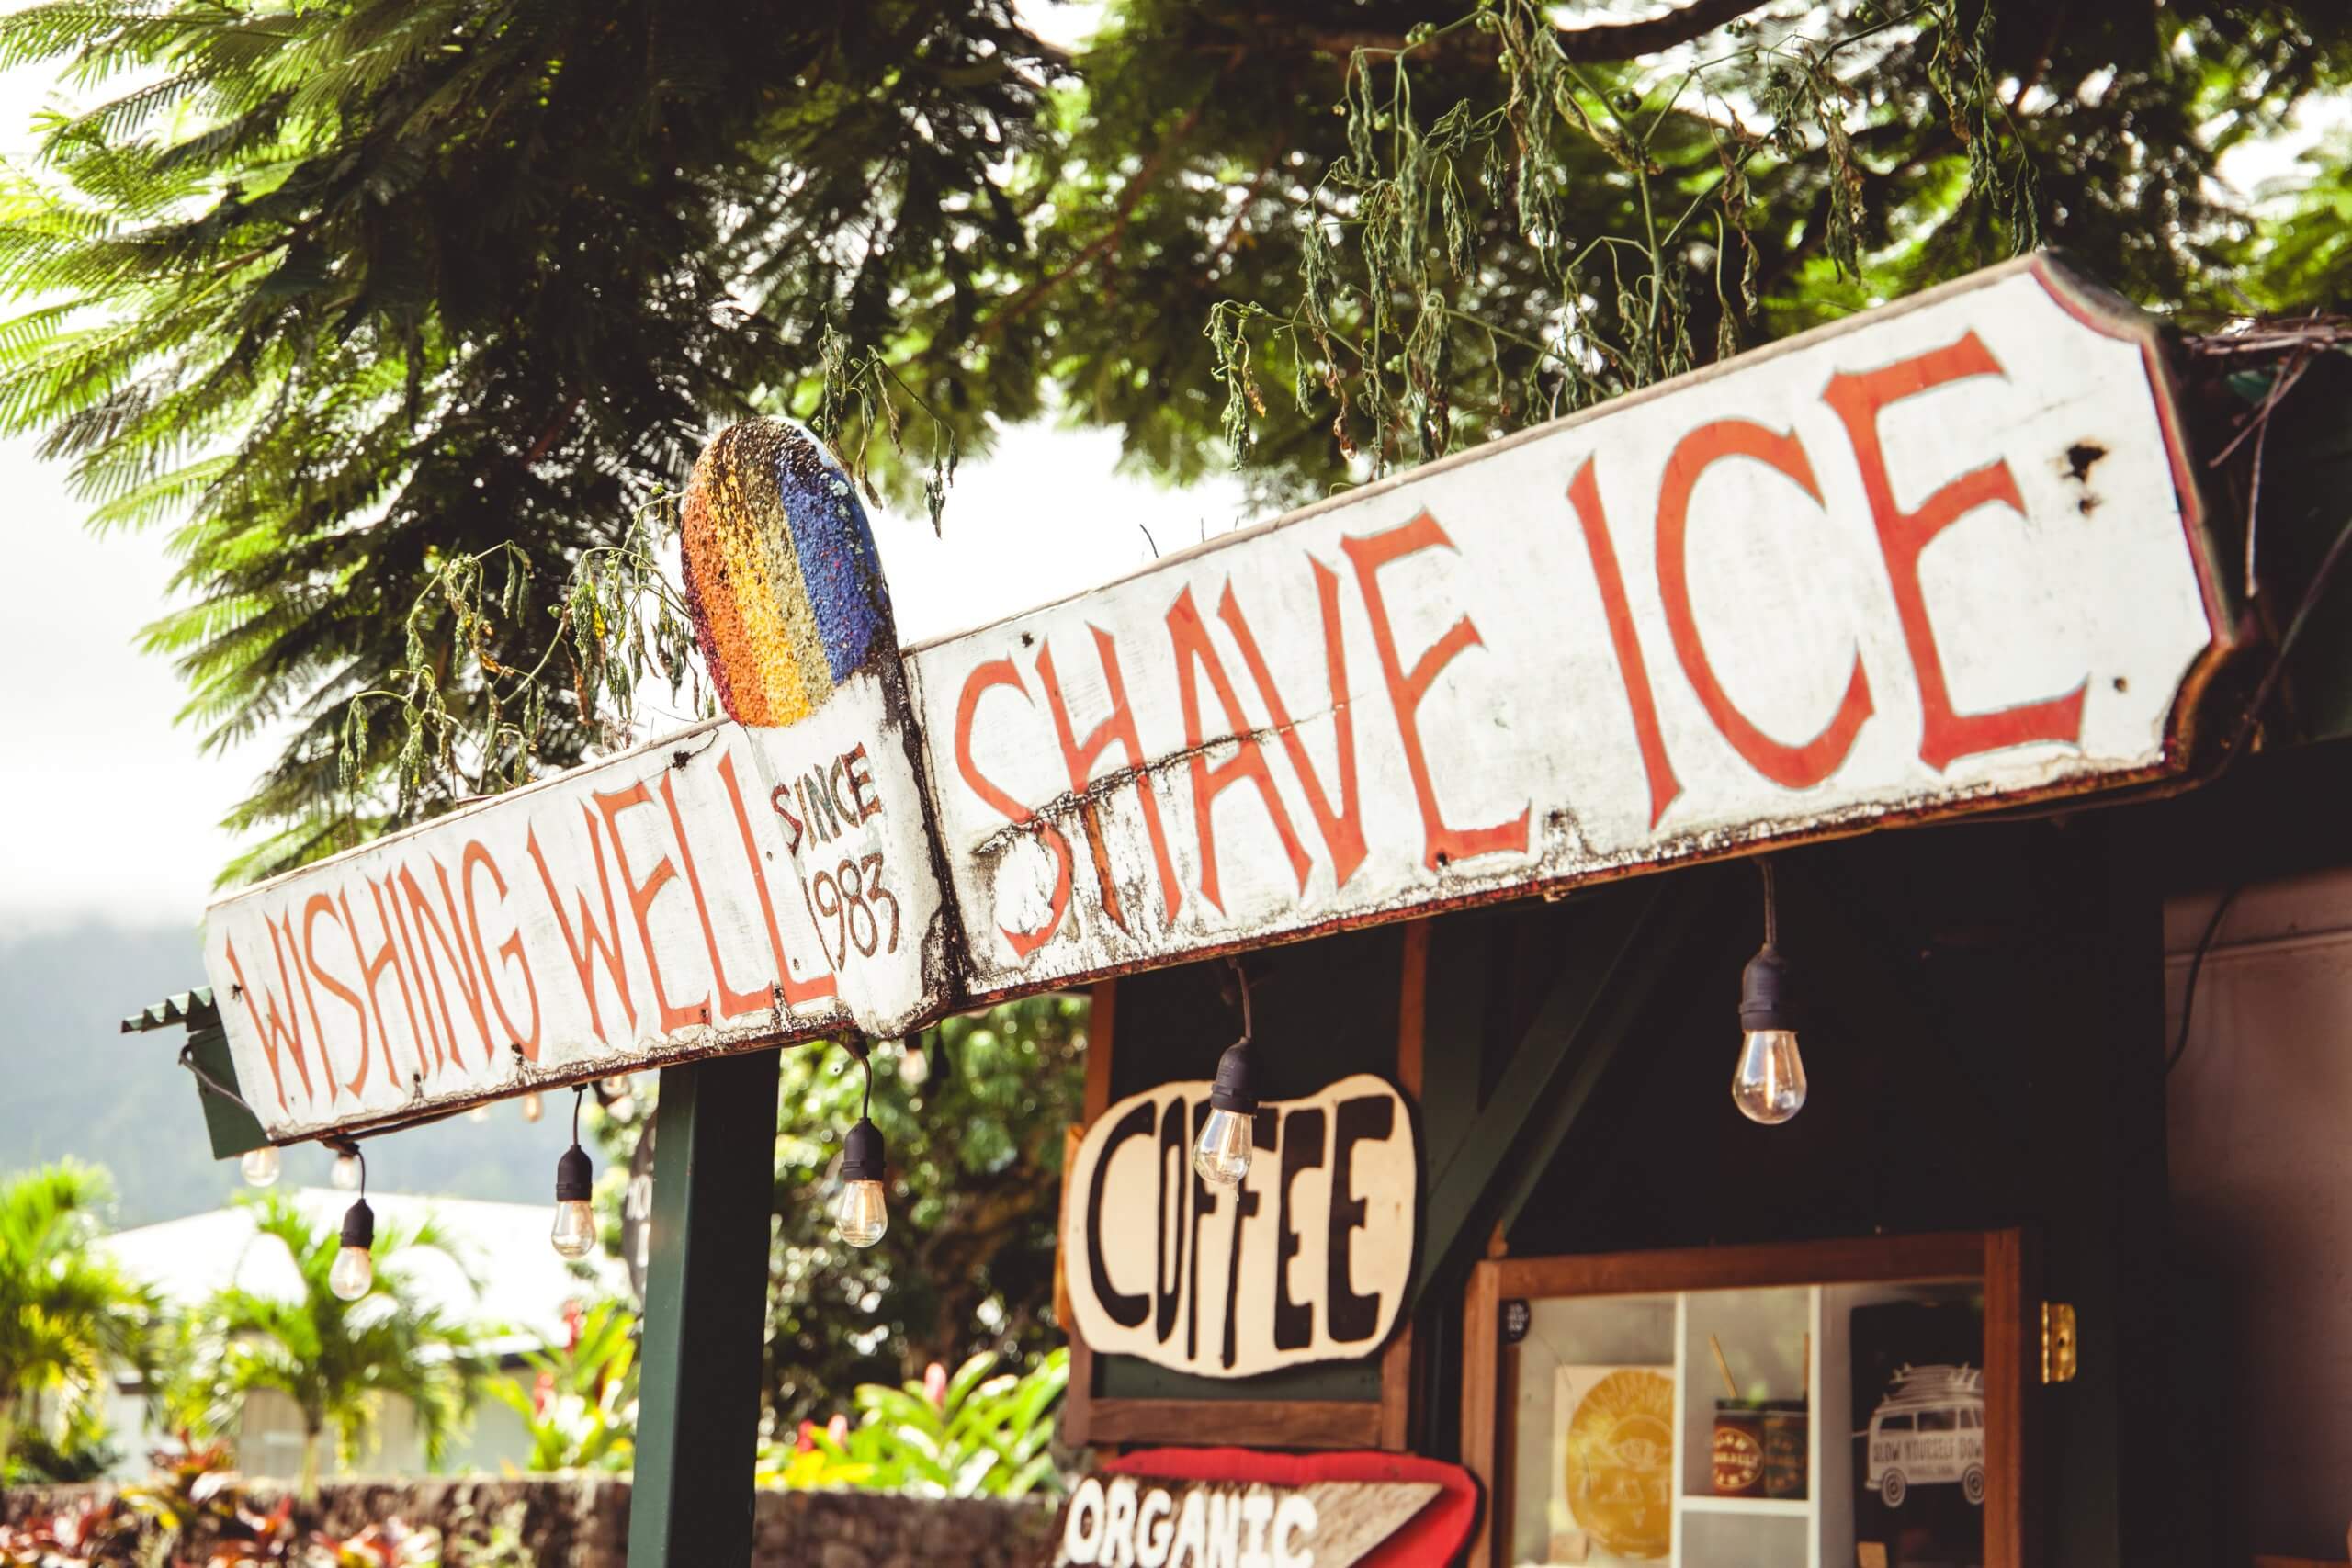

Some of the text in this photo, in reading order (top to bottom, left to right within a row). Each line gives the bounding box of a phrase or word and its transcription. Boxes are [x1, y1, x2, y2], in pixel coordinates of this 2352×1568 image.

[955, 328, 2091, 962] SHAVE ICE
[770, 741, 883, 858] SINCE
[225, 748, 839, 1113] WISHING WELL
[801, 851, 900, 973] 1983
[1086, 1094, 1395, 1371] COFFEE
[1872, 1440, 1901, 1463] SLOW
[1959, 1436, 1985, 1461] DOW
[1063, 1476, 1318, 1568] ORGANIC
